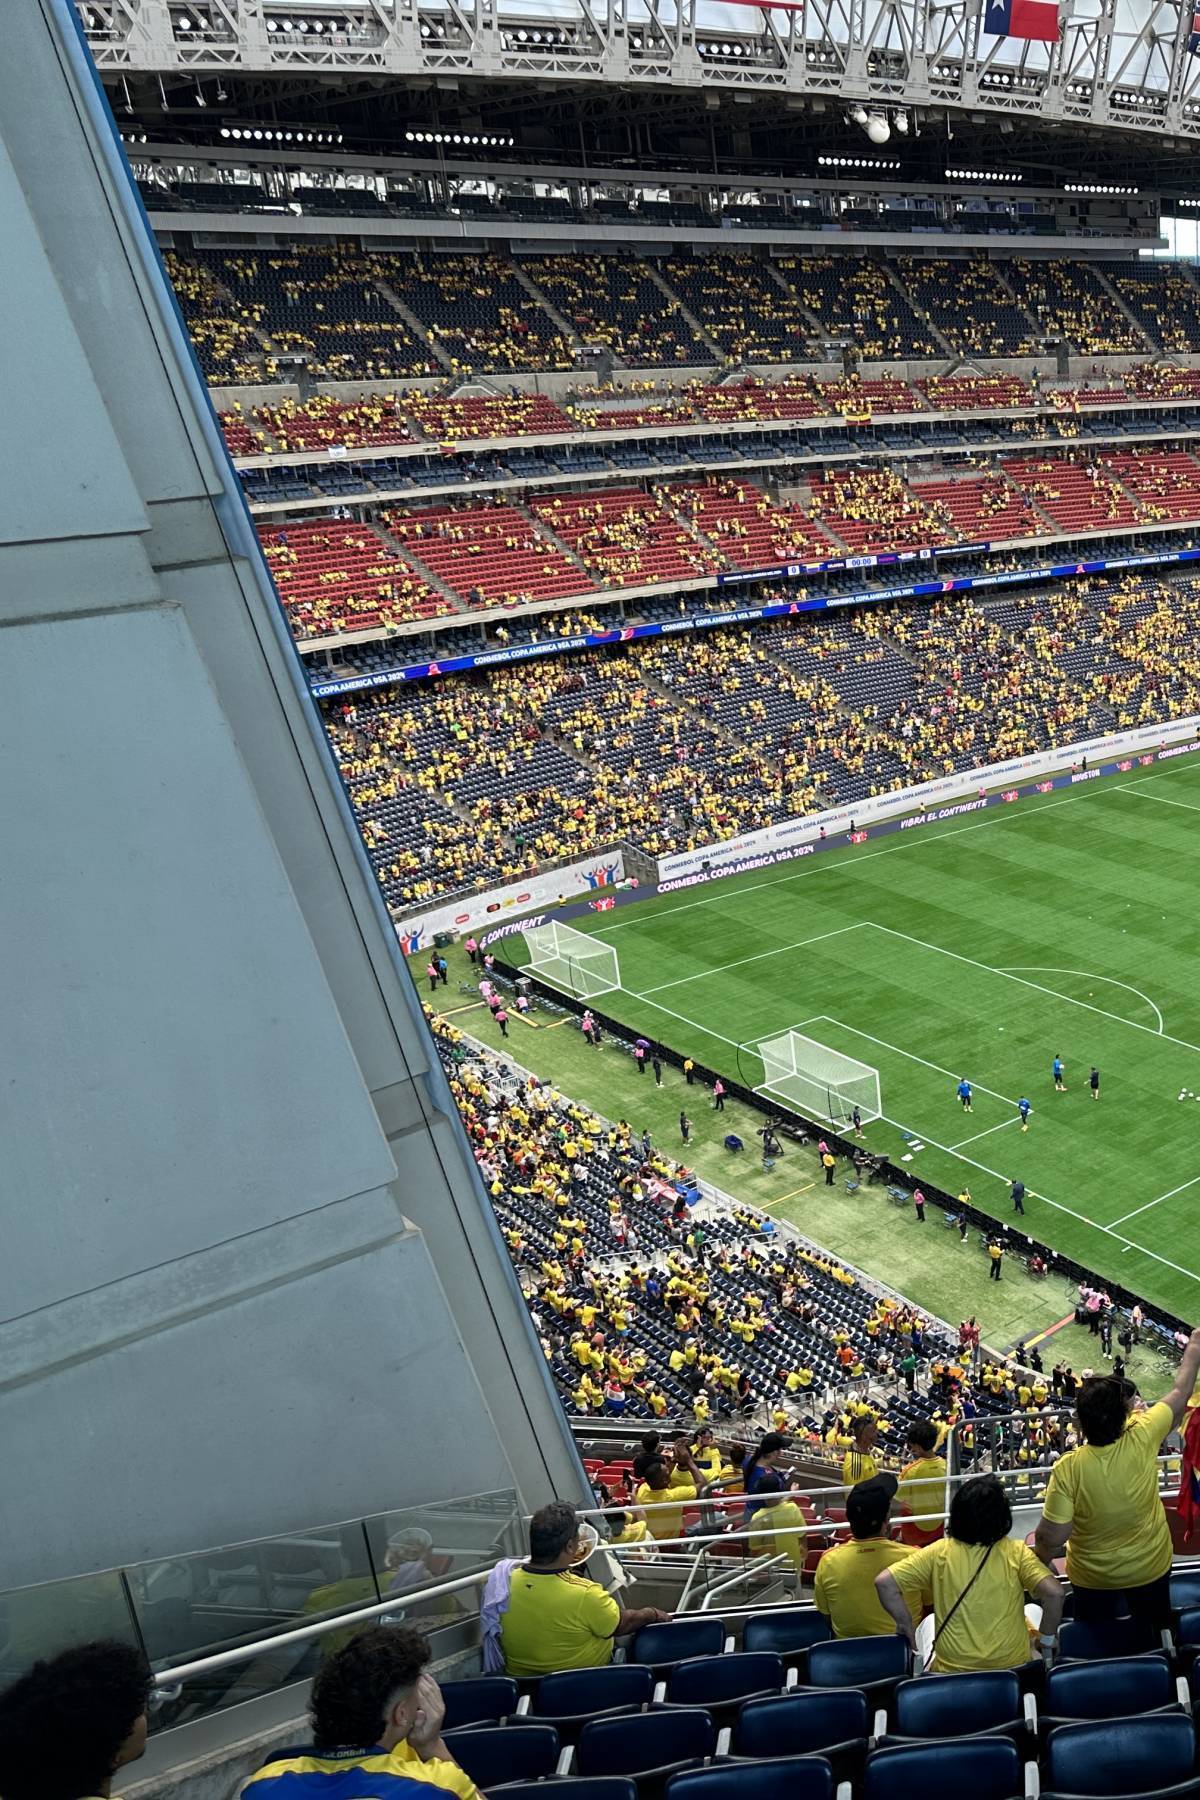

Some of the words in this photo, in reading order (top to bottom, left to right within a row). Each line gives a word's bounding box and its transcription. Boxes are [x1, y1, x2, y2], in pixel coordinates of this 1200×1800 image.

[474, 652, 512, 665] CONMEBOL
[511, 648, 528, 658] COPA
[528, 644, 556, 655] AMERICA
[557, 640, 570, 649] USA
[570, 638, 587, 647] 2024
[319, 686, 340, 695] COPA
[340, 678, 372, 692] AMERICA
[373, 675, 388, 684] USA
[388, 672, 406, 681] 2024
[900, 814, 926, 829] VIBRA
[926, 812, 938, 822] EL
[938, 798, 988, 818] CONTINENTE
[657, 872, 710, 893] CONMEBOL
[710, 865, 736, 879] COPA
[736, 854, 776, 872] AMERICA
[776, 848, 794, 860] USA
[793, 845, 814, 857] 2024
